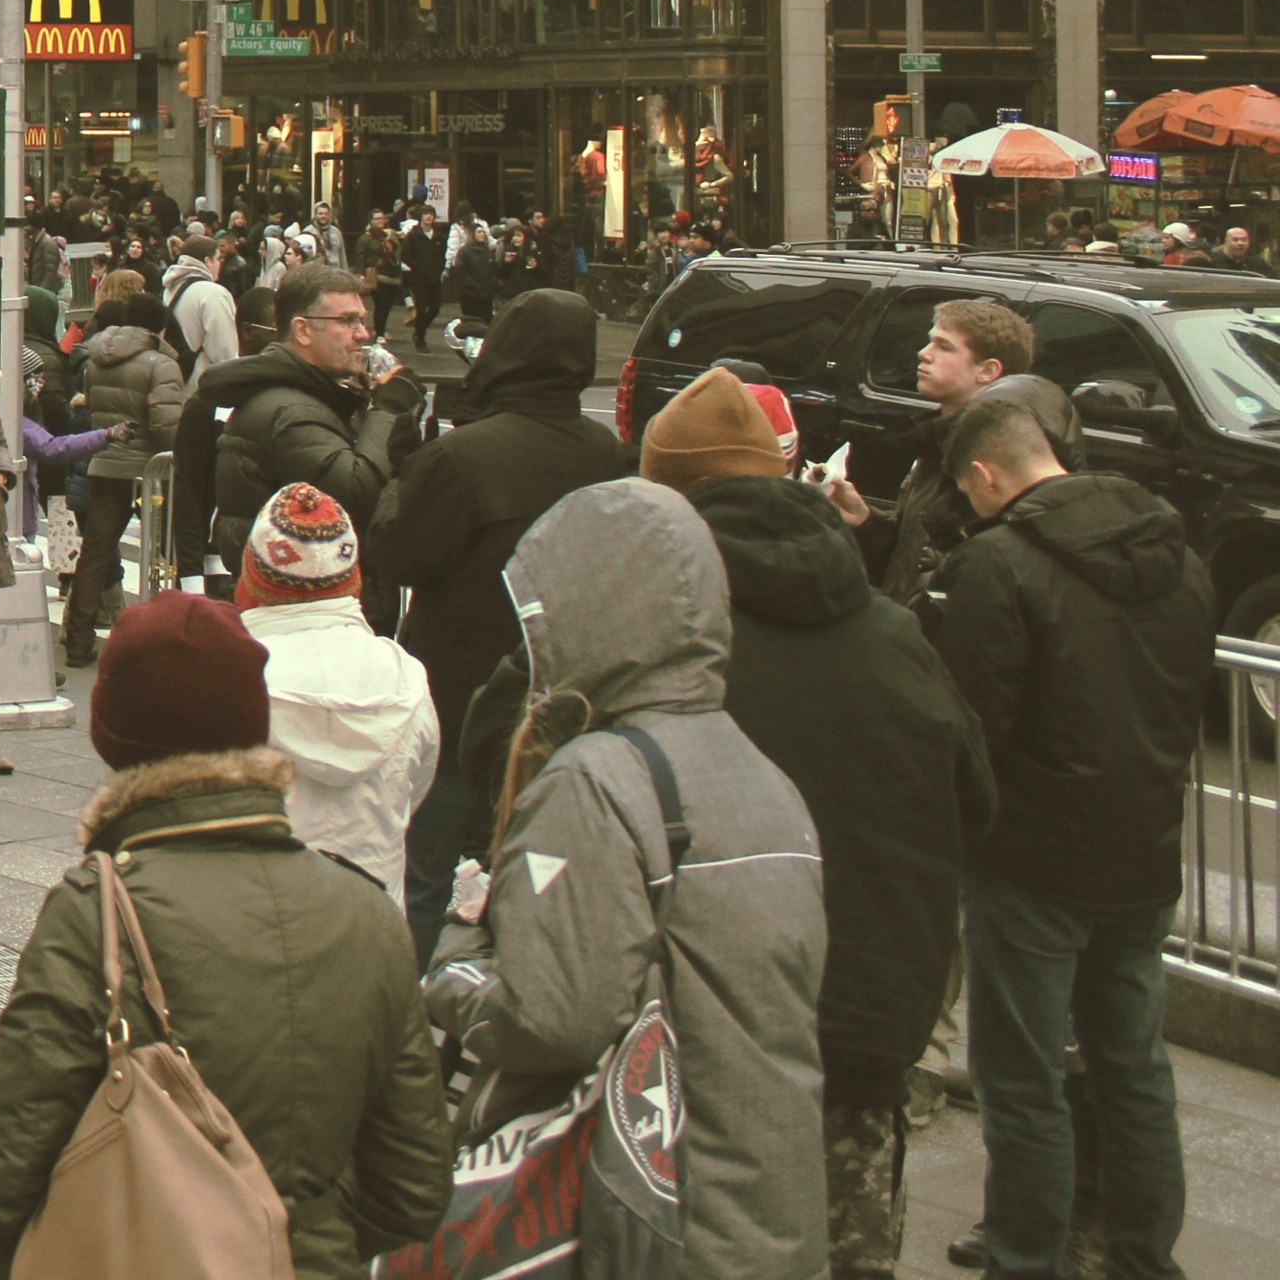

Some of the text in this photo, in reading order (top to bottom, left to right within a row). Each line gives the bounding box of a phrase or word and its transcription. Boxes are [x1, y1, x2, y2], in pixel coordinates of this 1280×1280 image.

[235, 23, 262, 37] W 46
[231, 40, 303, 51] Actors' Equity
[439, 113, 506, 134] EXPRESS
